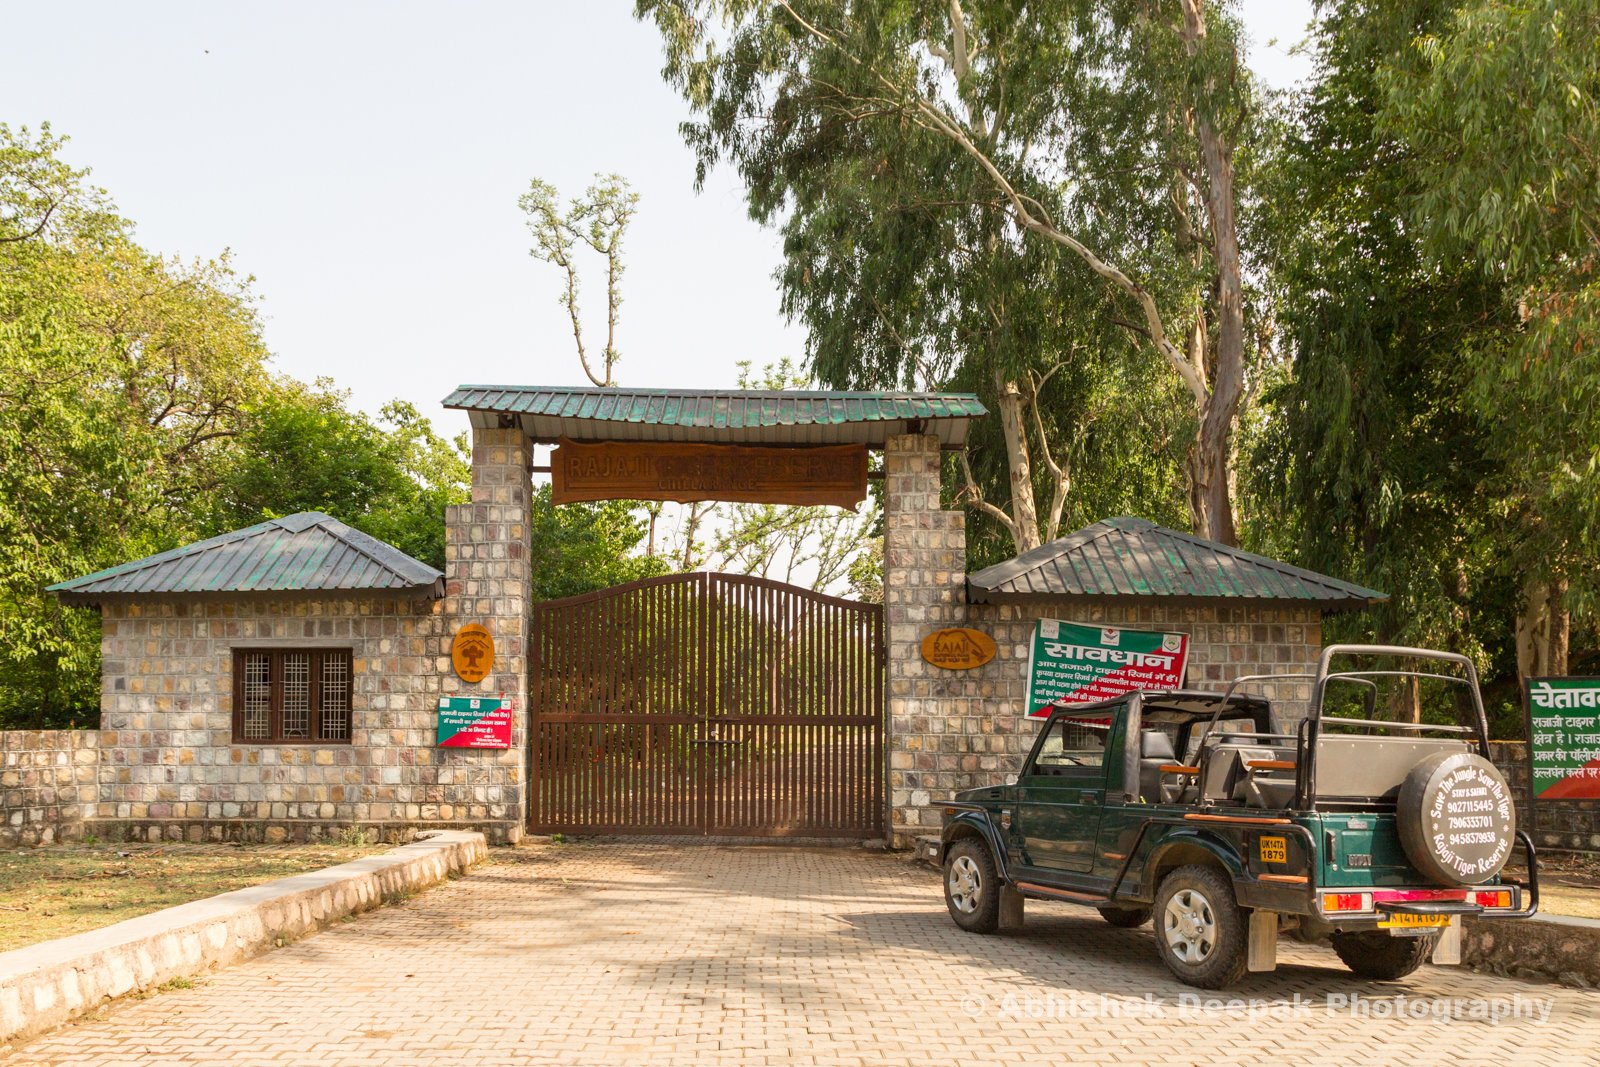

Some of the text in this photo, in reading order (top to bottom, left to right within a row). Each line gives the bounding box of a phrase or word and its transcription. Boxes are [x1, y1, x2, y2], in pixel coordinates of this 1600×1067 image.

[568, 455, 650, 477] RAJAJI
[1044, 642, 1175, 671] सावधान
[1036, 661, 1057, 669] आप
[1059, 663, 1093, 672] राजाजी
[1096, 667, 1126, 677] टाइगर
[1128, 669, 1154, 679] रिजर्व
[1155, 673, 1166, 681] में
[1055, 672, 1074, 680] टाइगर
[1075, 672, 1091, 681] रिजर्व
[1532, 714, 1564, 728] राजाजी
[1565, 717, 1596, 730] टाइगर
[1533, 730, 1554, 746] क्षेत्र
[1555, 730, 1565, 746] है
[1533, 751, 1555, 761] प्रकार
[1555, 748, 1567, 761] की
[1566, 764, 1586, 779] करने
[1586, 768, 1598, 779] पर
[1430, 766, 1510, 821] Save The Jungle Save The Tiger
[1447, 800, 1494, 813] 9027115445
[1448, 816, 1493, 829] 7906333701
[1261, 840, 1284, 849] UK14TA
[1262, 850, 1284, 860] 1879
[1433, 833, 1508, 876] Rajaji Tiger Reserve
